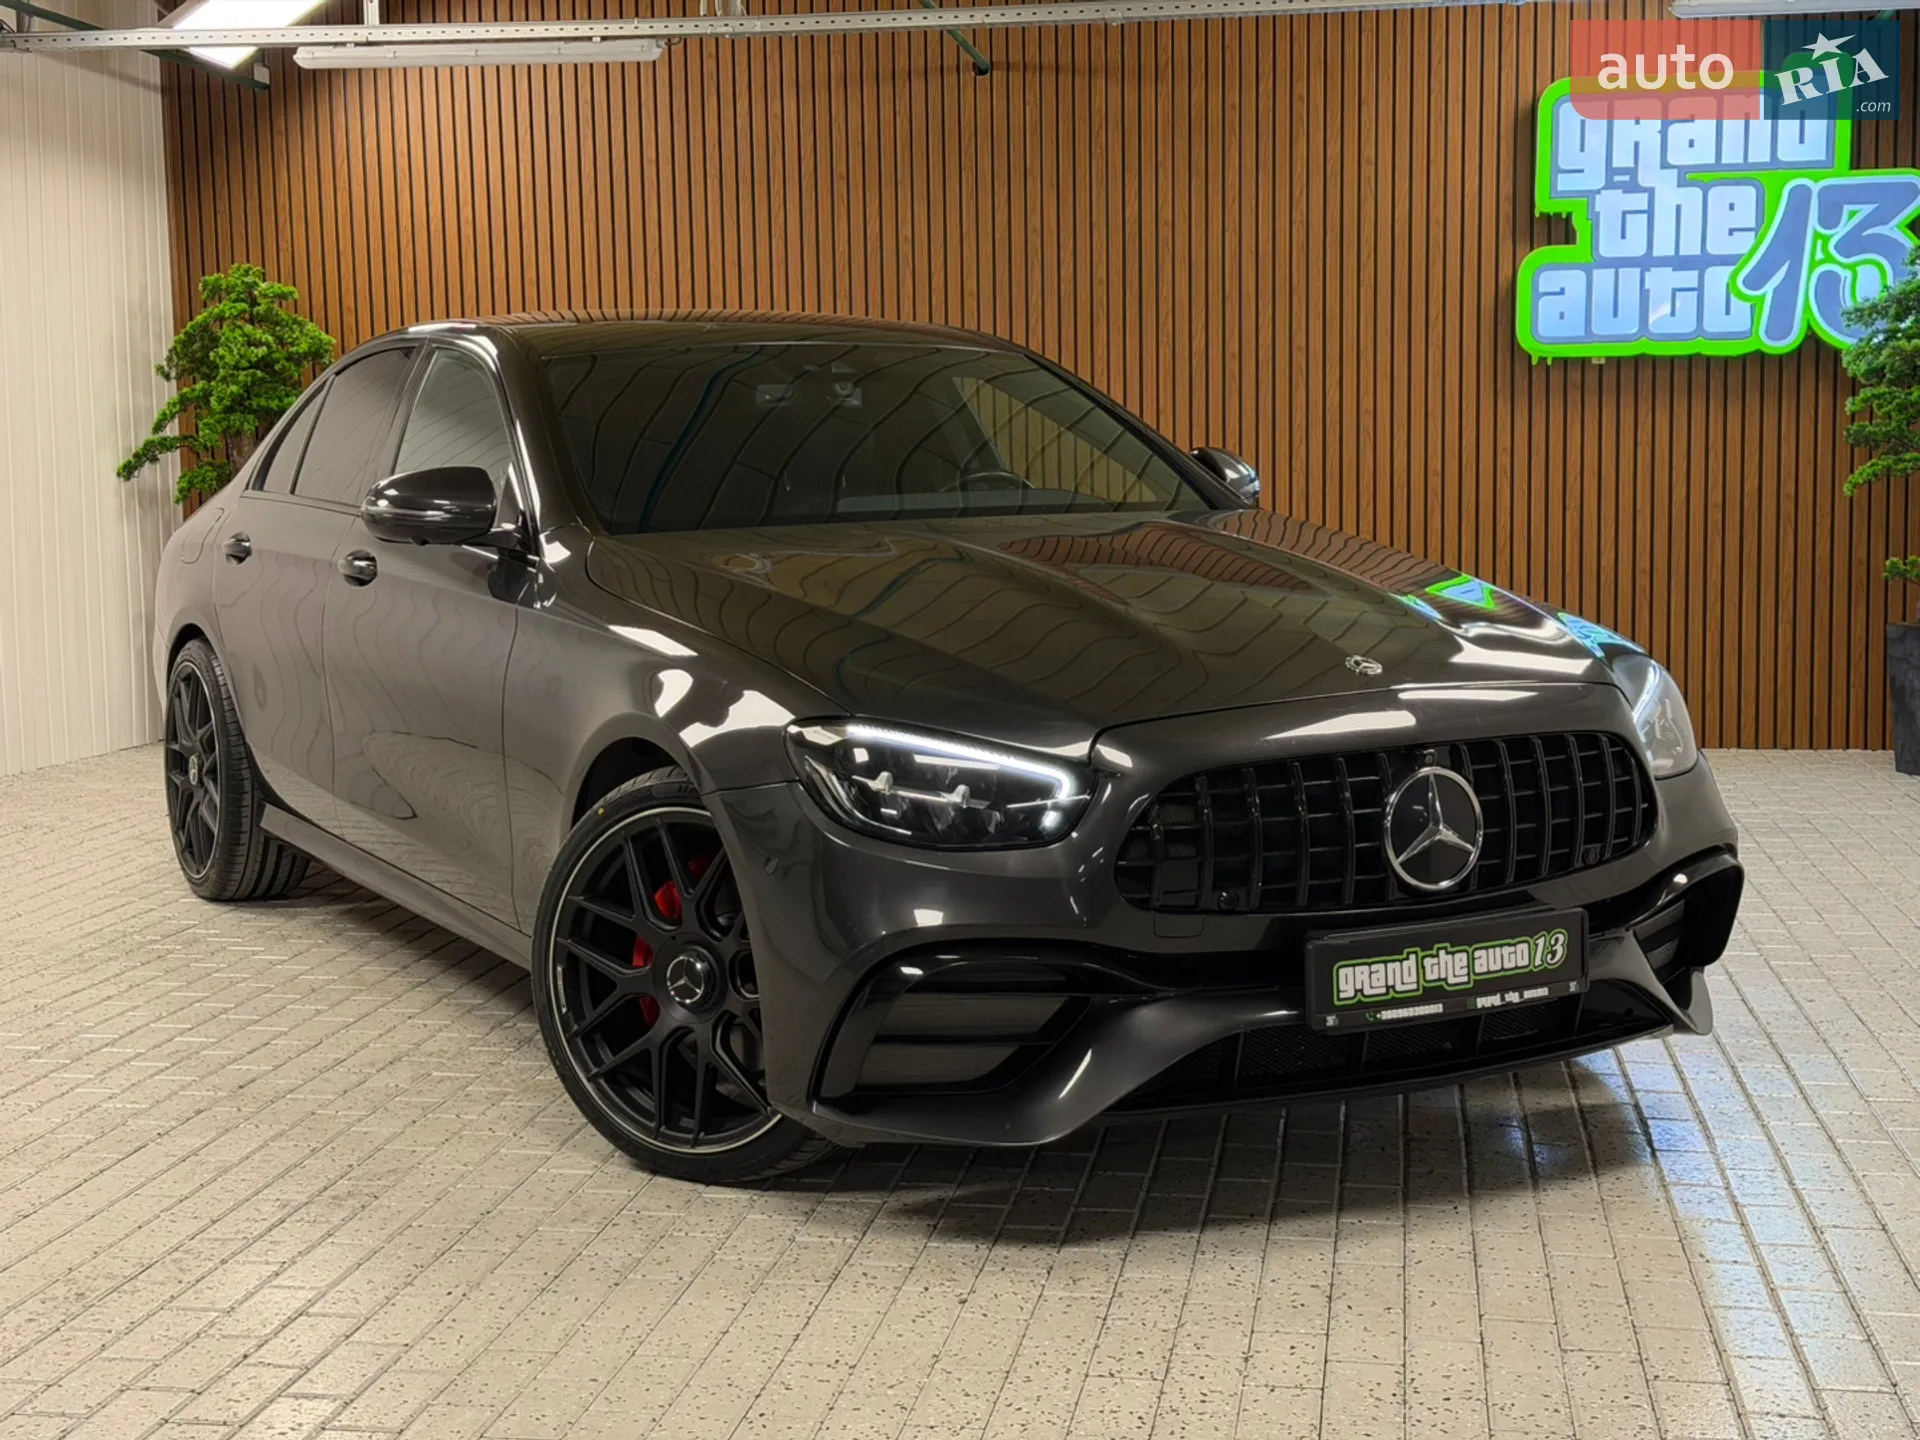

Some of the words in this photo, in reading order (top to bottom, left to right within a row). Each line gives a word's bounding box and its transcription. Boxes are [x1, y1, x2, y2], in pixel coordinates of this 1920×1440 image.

[1595, 170, 1756, 257] the
[1538, 265, 1753, 338] auto
[1736, 177, 1920, 347] 13
[1338, 952, 1419, 999] grand
[1424, 949, 1469, 984] the
[1474, 942, 1530, 975] auto
[1533, 933, 1565, 966] 13
